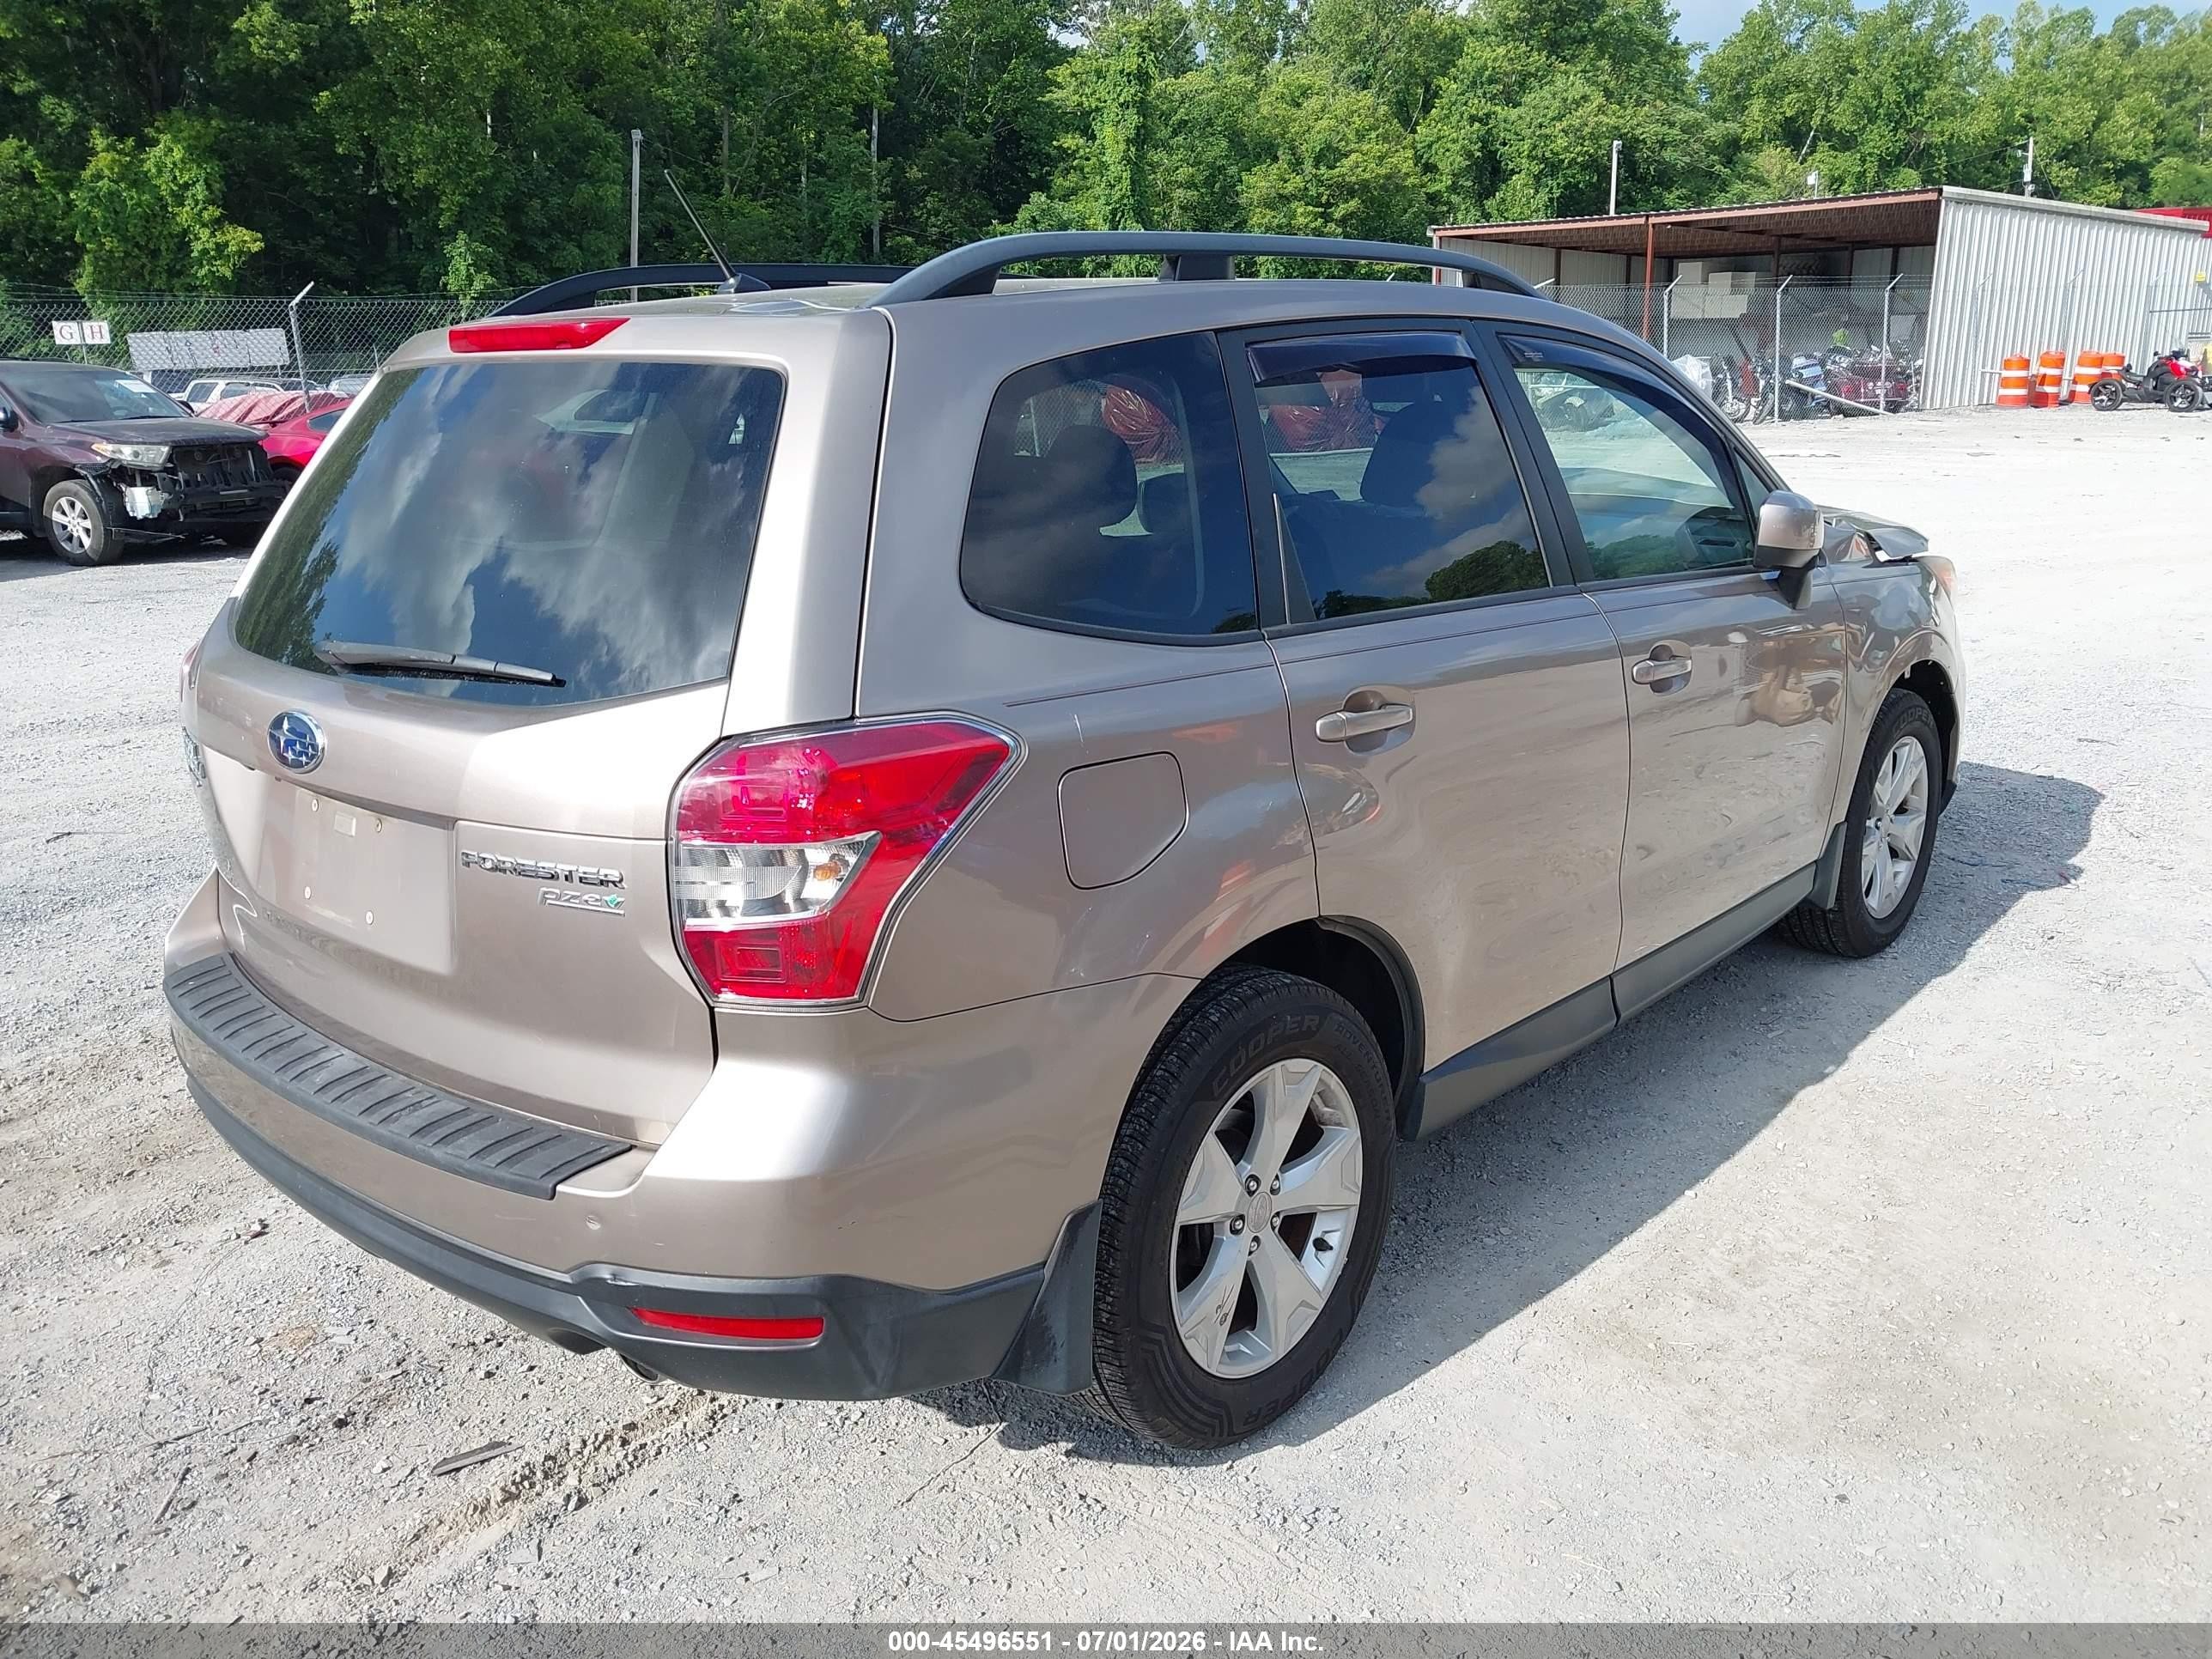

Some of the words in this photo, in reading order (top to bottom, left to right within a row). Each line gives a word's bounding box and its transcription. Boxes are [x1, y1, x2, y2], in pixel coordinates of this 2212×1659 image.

[59, 325, 74, 341] G
[89, 325, 104, 340] H
[461, 850, 627, 890] FORESTER
[1212, 1014, 1320, 1097] COOPER
[1243, 1328, 1344, 1426] COOPER
